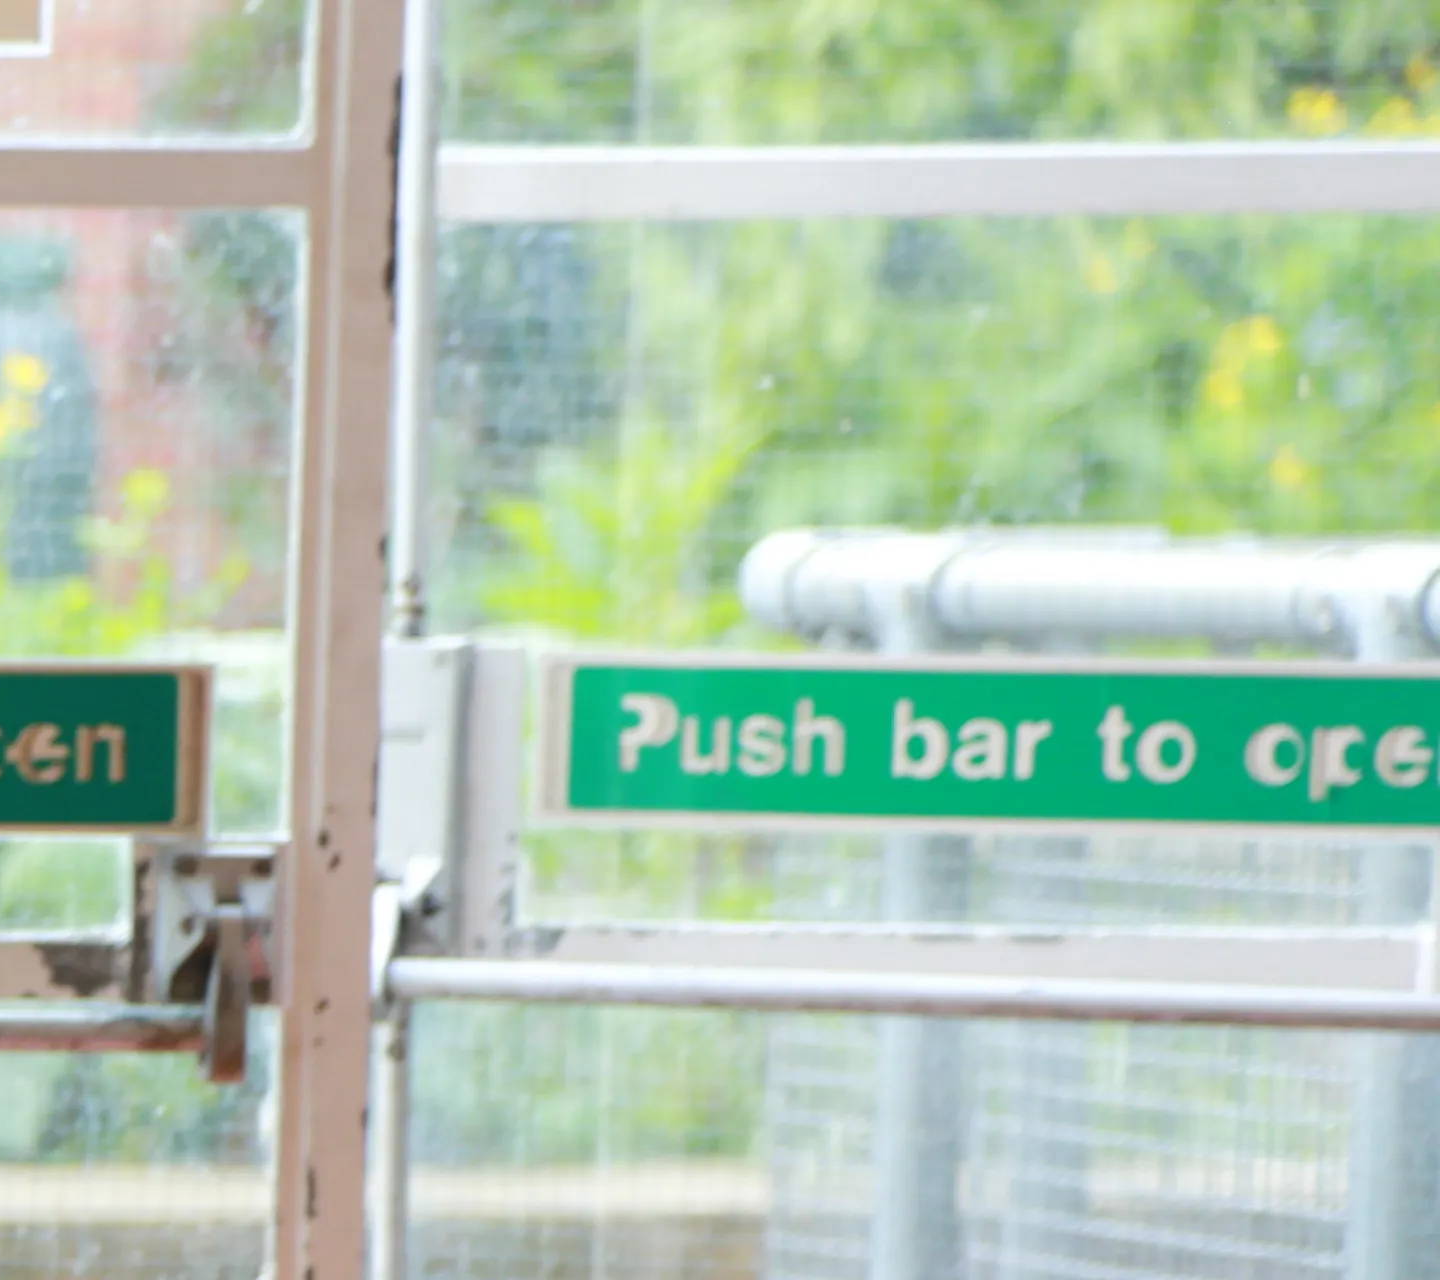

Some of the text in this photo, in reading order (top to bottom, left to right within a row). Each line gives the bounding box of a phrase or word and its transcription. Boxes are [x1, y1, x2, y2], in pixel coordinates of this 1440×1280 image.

[618, 692, 1440, 802] Push bar to ope
